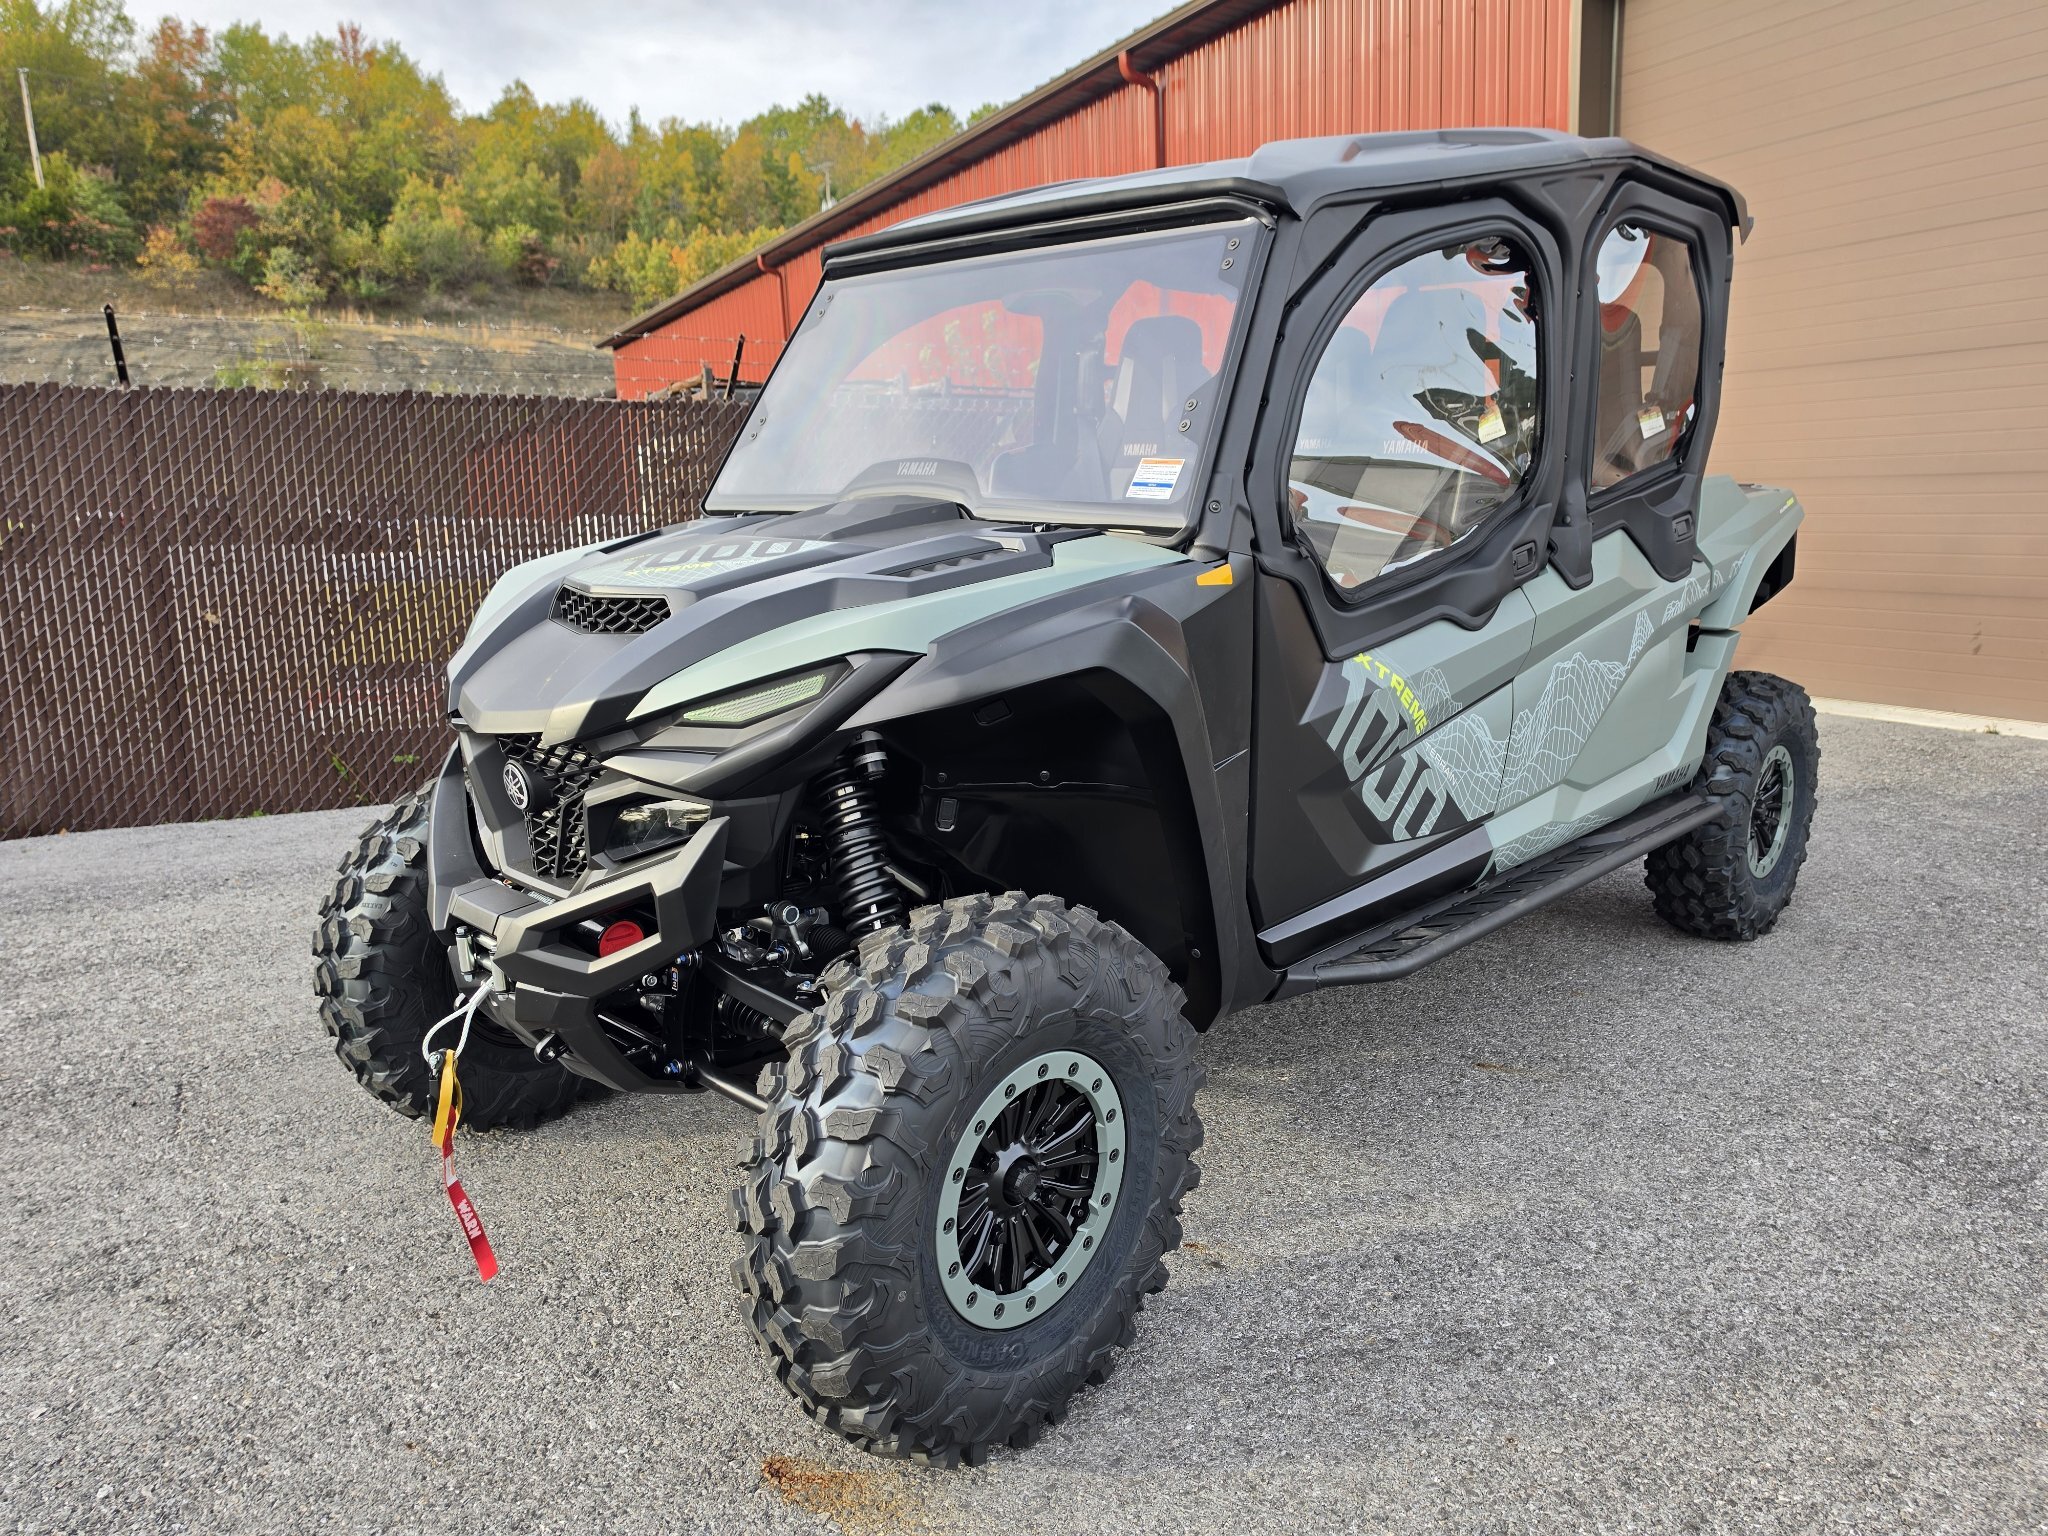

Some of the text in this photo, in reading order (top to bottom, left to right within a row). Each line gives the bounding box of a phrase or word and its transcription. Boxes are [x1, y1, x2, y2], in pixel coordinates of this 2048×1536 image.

[1124, 443, 1158, 456] YAMAHA
[1383, 439, 1429, 454] YAMAHA
[896, 461, 938, 476] YAMAHA
[1352, 652, 1430, 737] XTREME
[1653, 763, 1691, 793] YAMAHA
[457, 1198, 482, 1240] WARN
